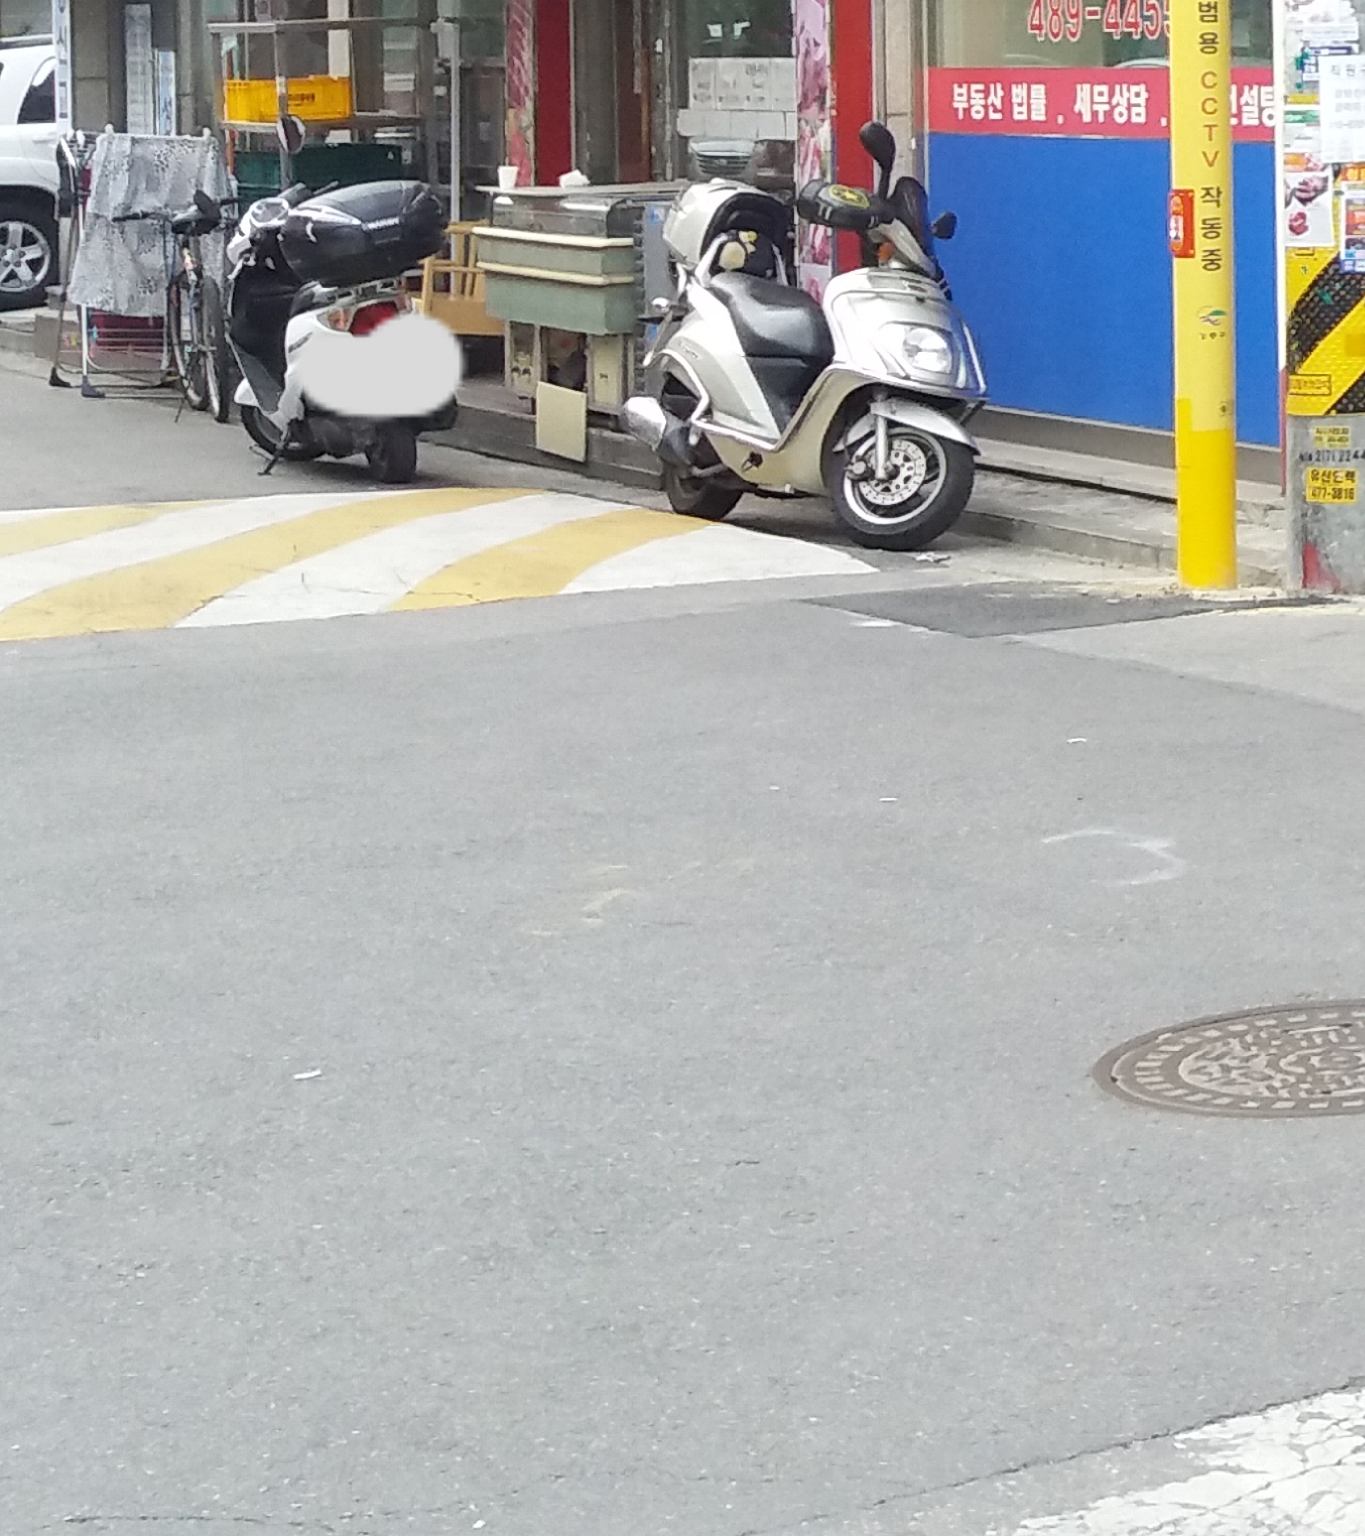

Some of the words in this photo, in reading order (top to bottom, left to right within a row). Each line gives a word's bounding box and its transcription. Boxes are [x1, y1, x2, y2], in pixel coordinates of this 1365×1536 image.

[951, 82, 1003, 121] 부동산
[1011, 83, 1047, 122] 법률
[1073, 84, 1150, 125] 세무상담
[1200, 70, 1220, 168] CCTV
[1200, 186, 1223, 271] 작동중
